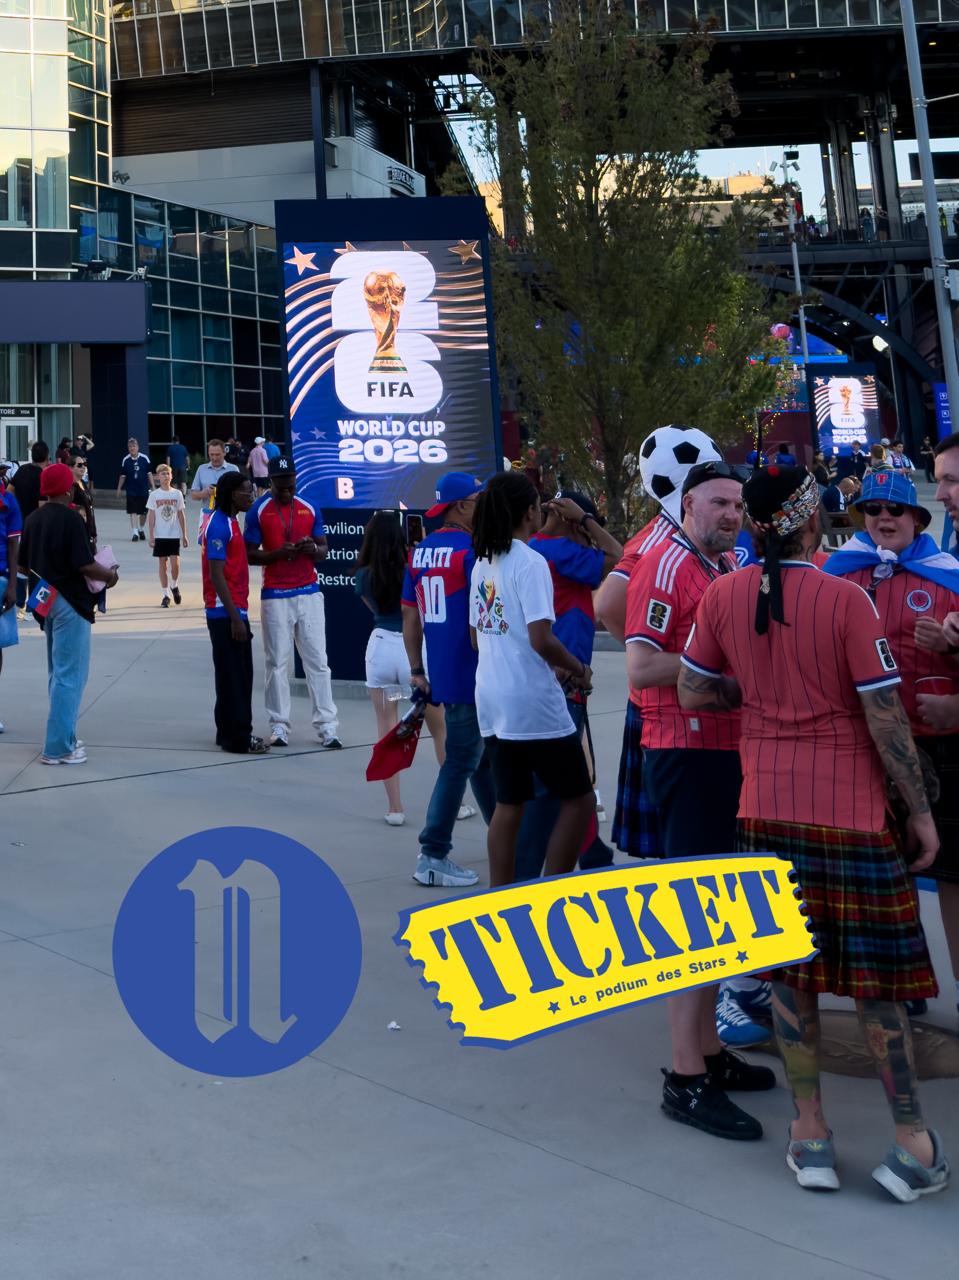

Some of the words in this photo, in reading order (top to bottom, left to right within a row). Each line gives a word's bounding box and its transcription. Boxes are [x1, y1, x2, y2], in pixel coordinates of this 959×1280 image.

[366, 381, 415, 398] FIFA
[337, 420, 406, 436] WORLD
[407, 420, 446, 436] CUP
[338, 438, 448, 463] 2026
[322, 522, 365, 535] avilion
[326, 548, 360, 560] atriot
[412, 547, 454, 569] HAITI
[316, 573, 357, 586] Restro
[421, 575, 447, 624] 10
